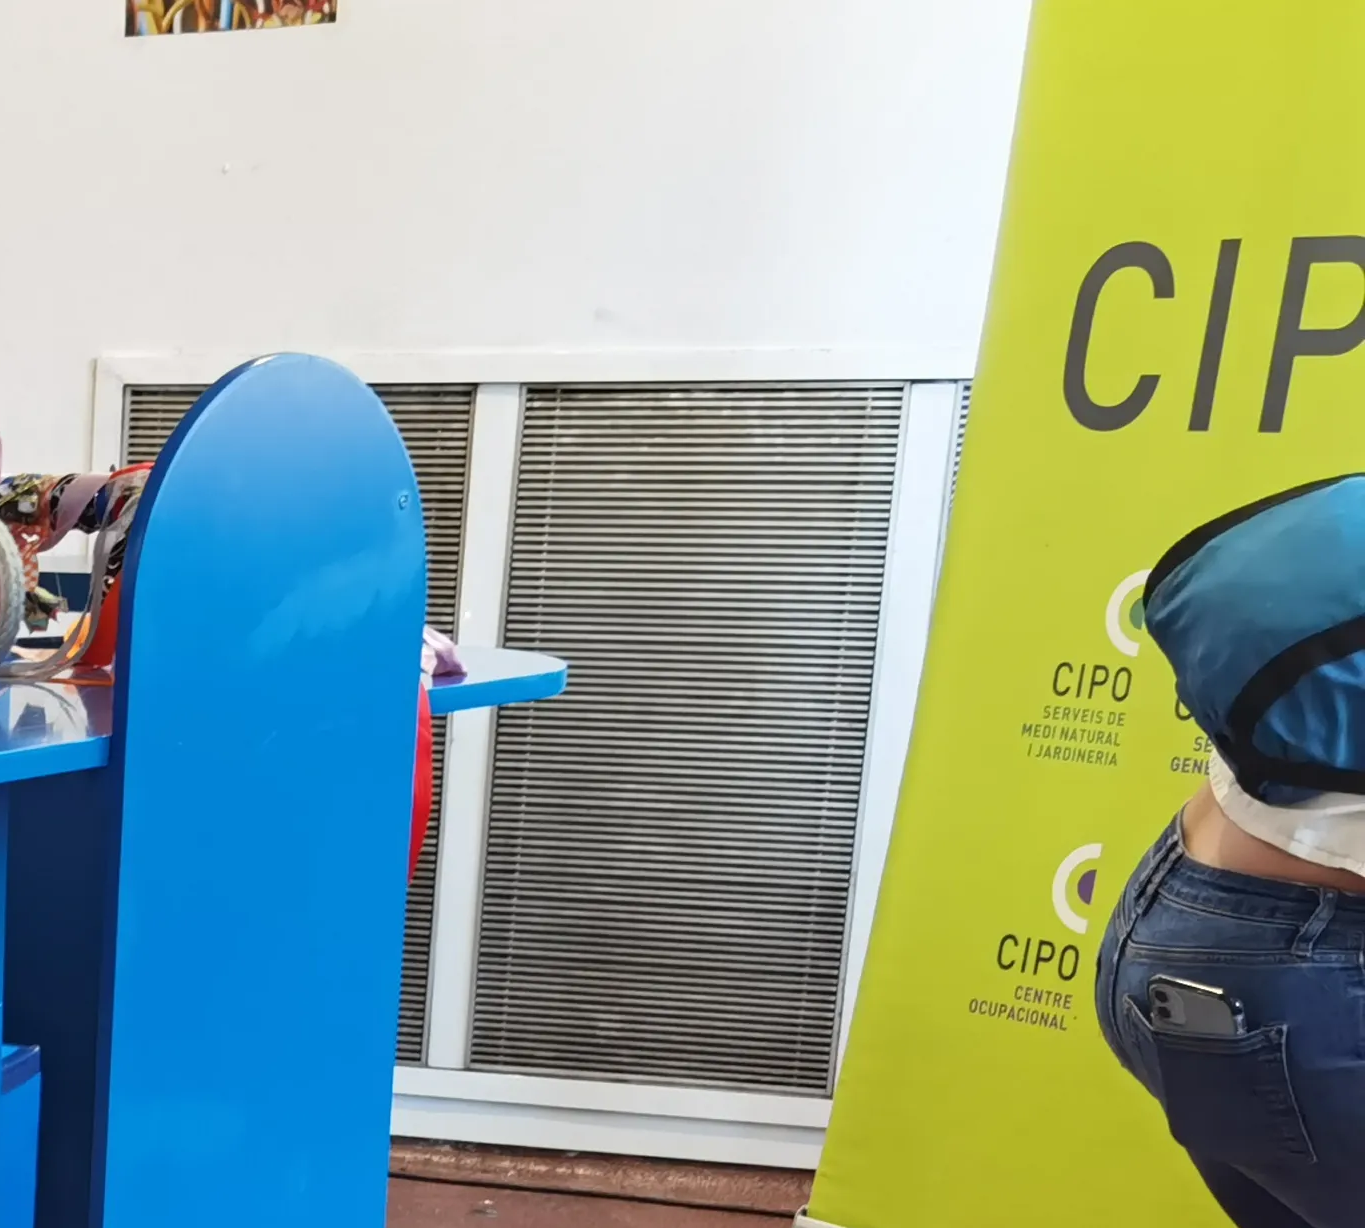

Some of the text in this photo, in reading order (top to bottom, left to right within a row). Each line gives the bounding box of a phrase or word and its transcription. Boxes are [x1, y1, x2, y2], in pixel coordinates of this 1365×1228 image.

[1052, 661, 1132, 702] CIPO
[1042, 705, 1127, 727] SERVEIS DE
[1021, 723, 1121, 748] MEDI NATURAL
[1027, 743, 1118, 767] I JARDINERIA
[996, 933, 1080, 982] CIPO
[1014, 985, 1073, 1010] CENTRE
[969, 998, 1068, 1031] OCUPACIONAL
